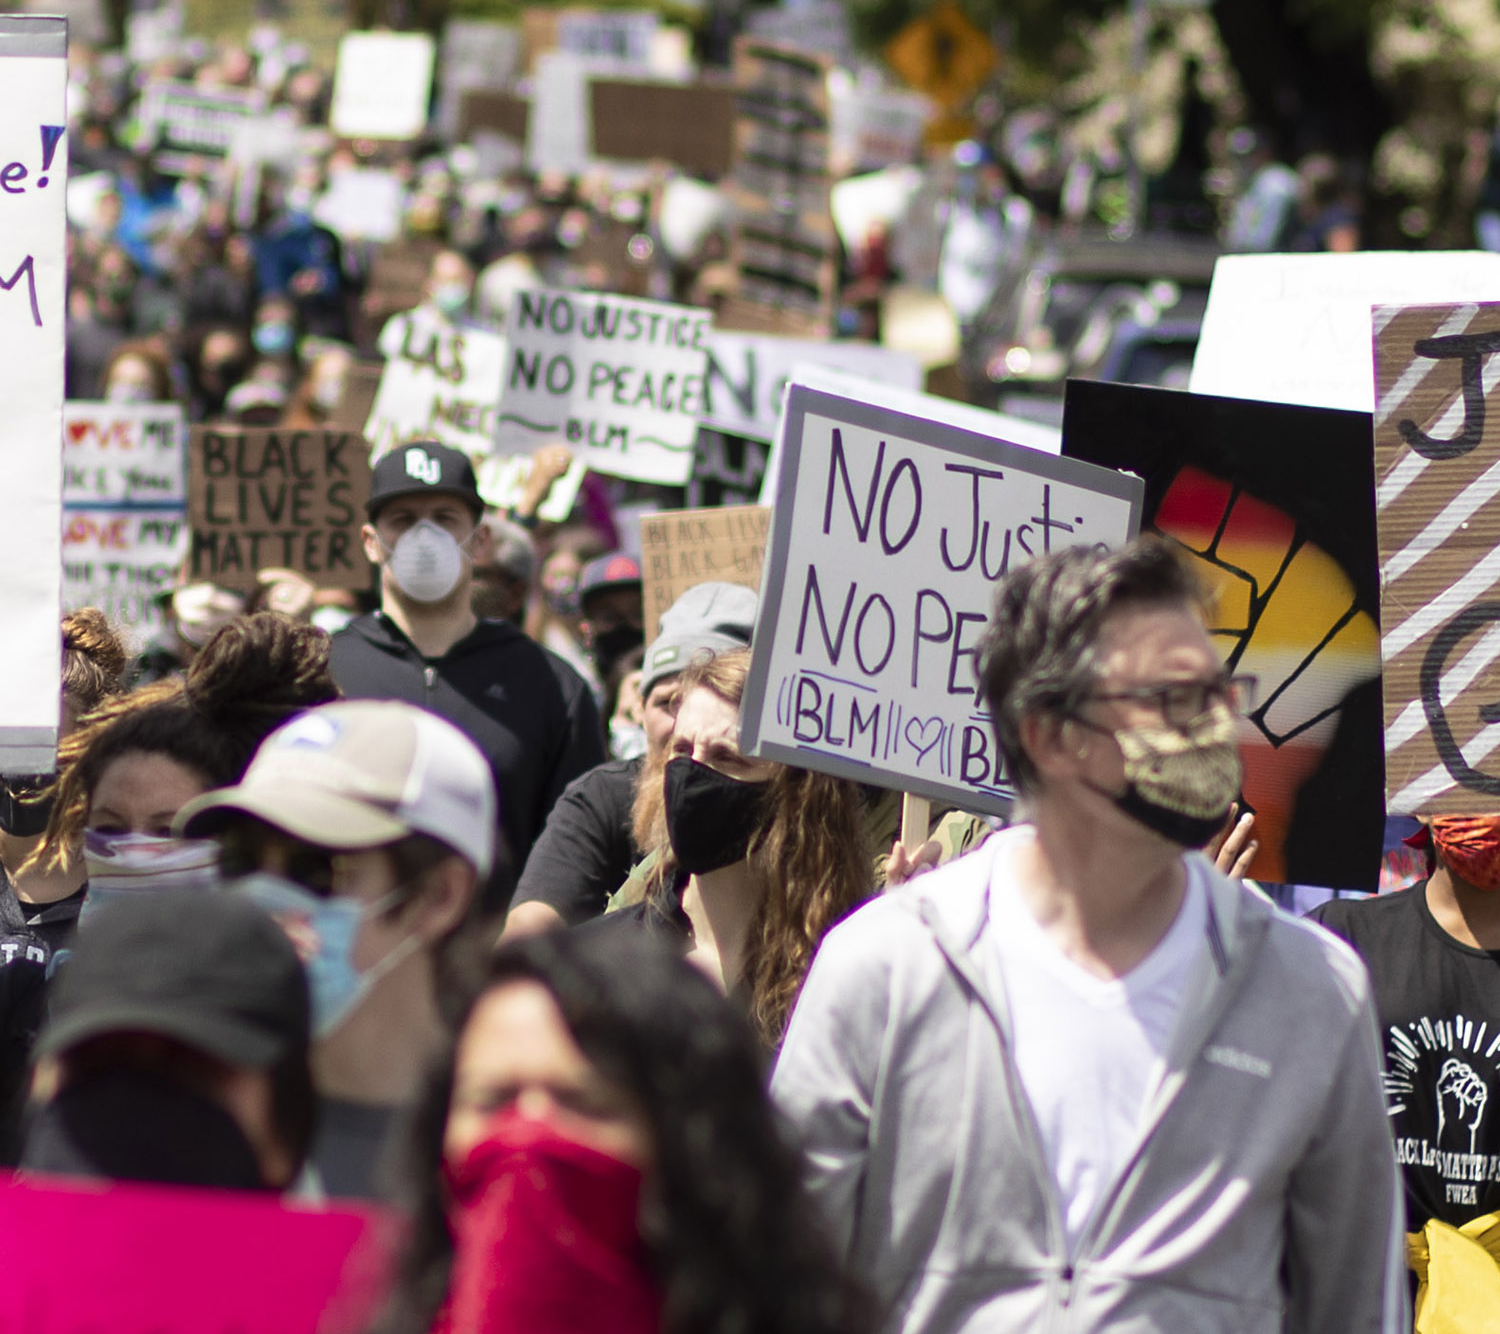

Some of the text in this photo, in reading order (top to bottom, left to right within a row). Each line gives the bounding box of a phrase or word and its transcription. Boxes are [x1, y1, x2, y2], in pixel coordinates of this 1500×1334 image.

[518, 289, 710, 351] NO JUSTICE
[510, 348, 703, 415] NO PEACE
[202, 430, 350, 480] BLACK
[565, 418, 630, 453] BLM
[205, 481, 355, 527] LIVES
[823, 427, 923, 556] NO
[940, 463, 1086, 582] Just
[190, 528, 353, 576] MATTER
[795, 565, 990, 712] NO PE
[793, 677, 880, 759] BLM
